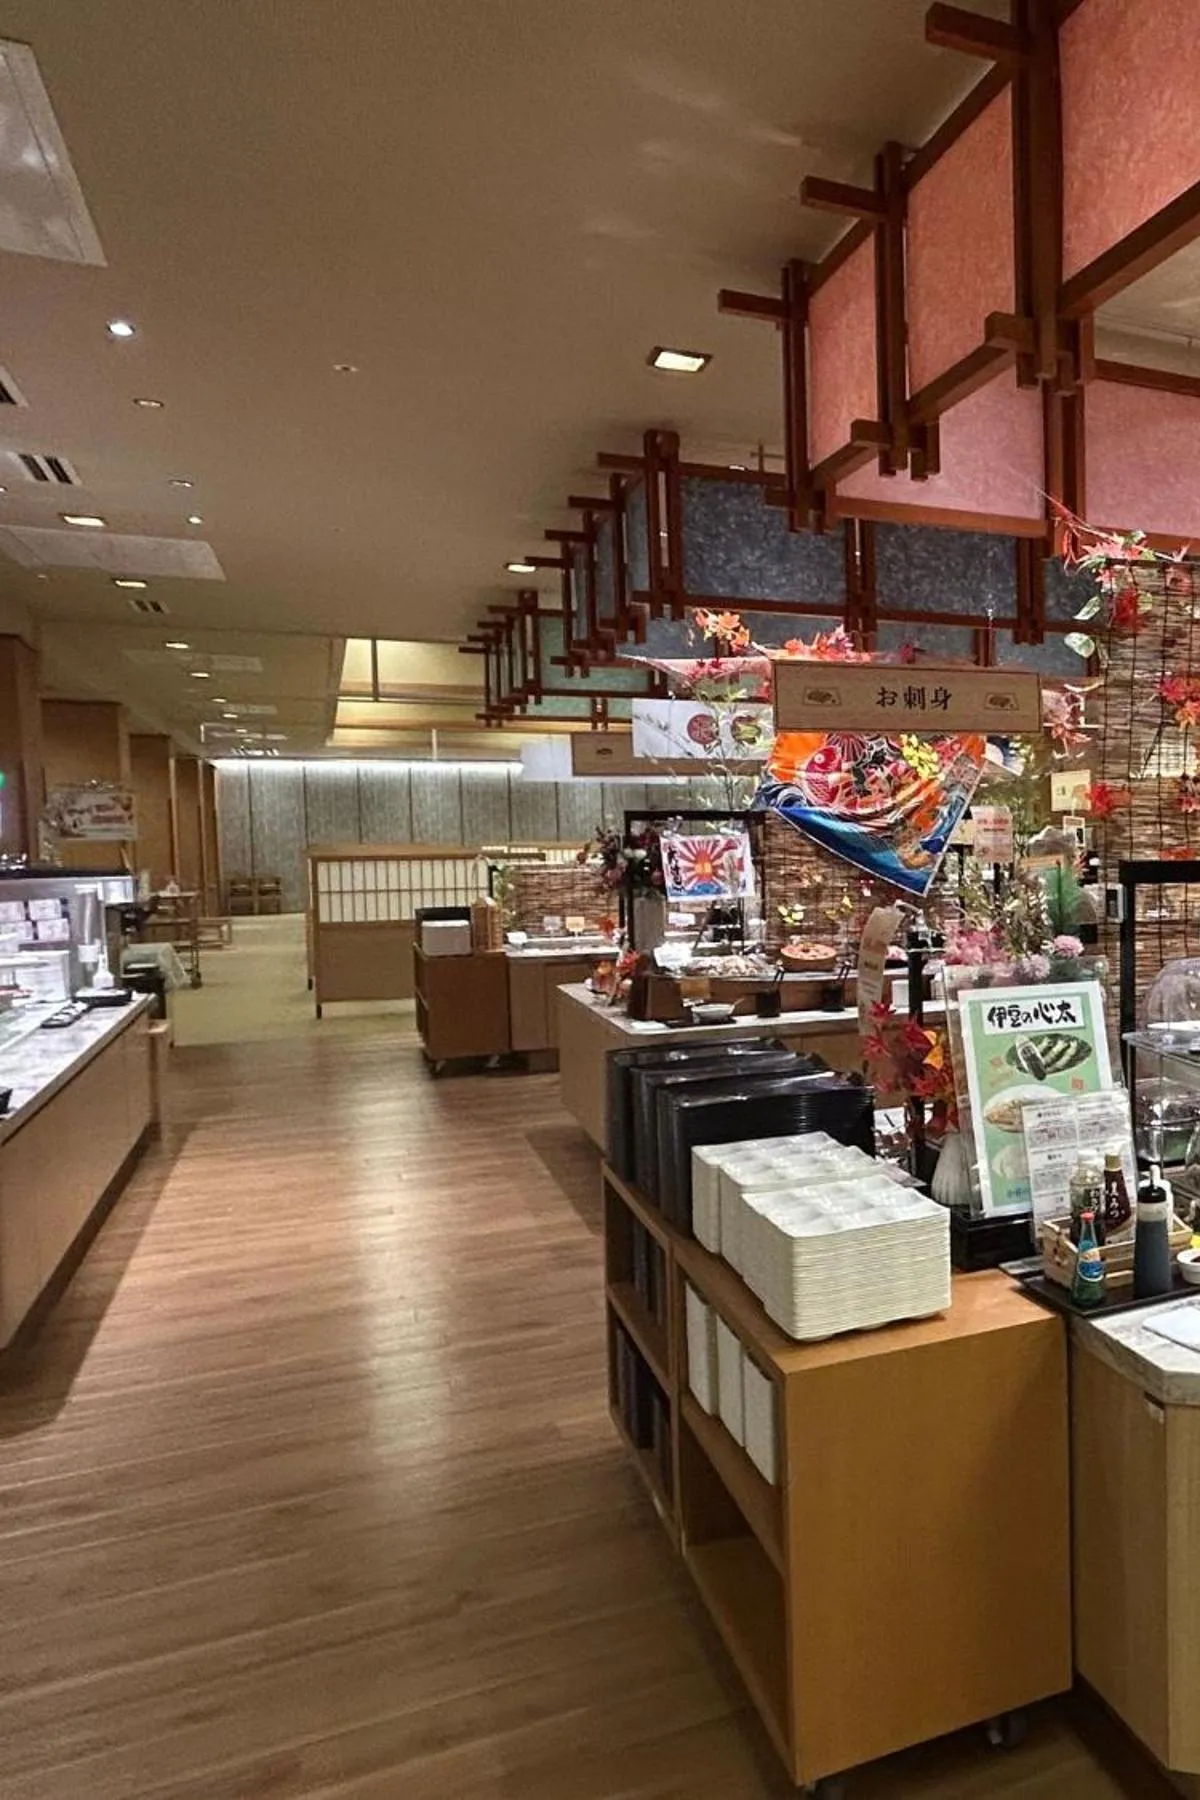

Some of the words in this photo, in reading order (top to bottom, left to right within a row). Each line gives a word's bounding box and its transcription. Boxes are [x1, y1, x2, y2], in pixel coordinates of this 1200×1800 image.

[876, 686, 952, 710] お刺身
[987, 999, 1077, 1029] 伊豆の心太
